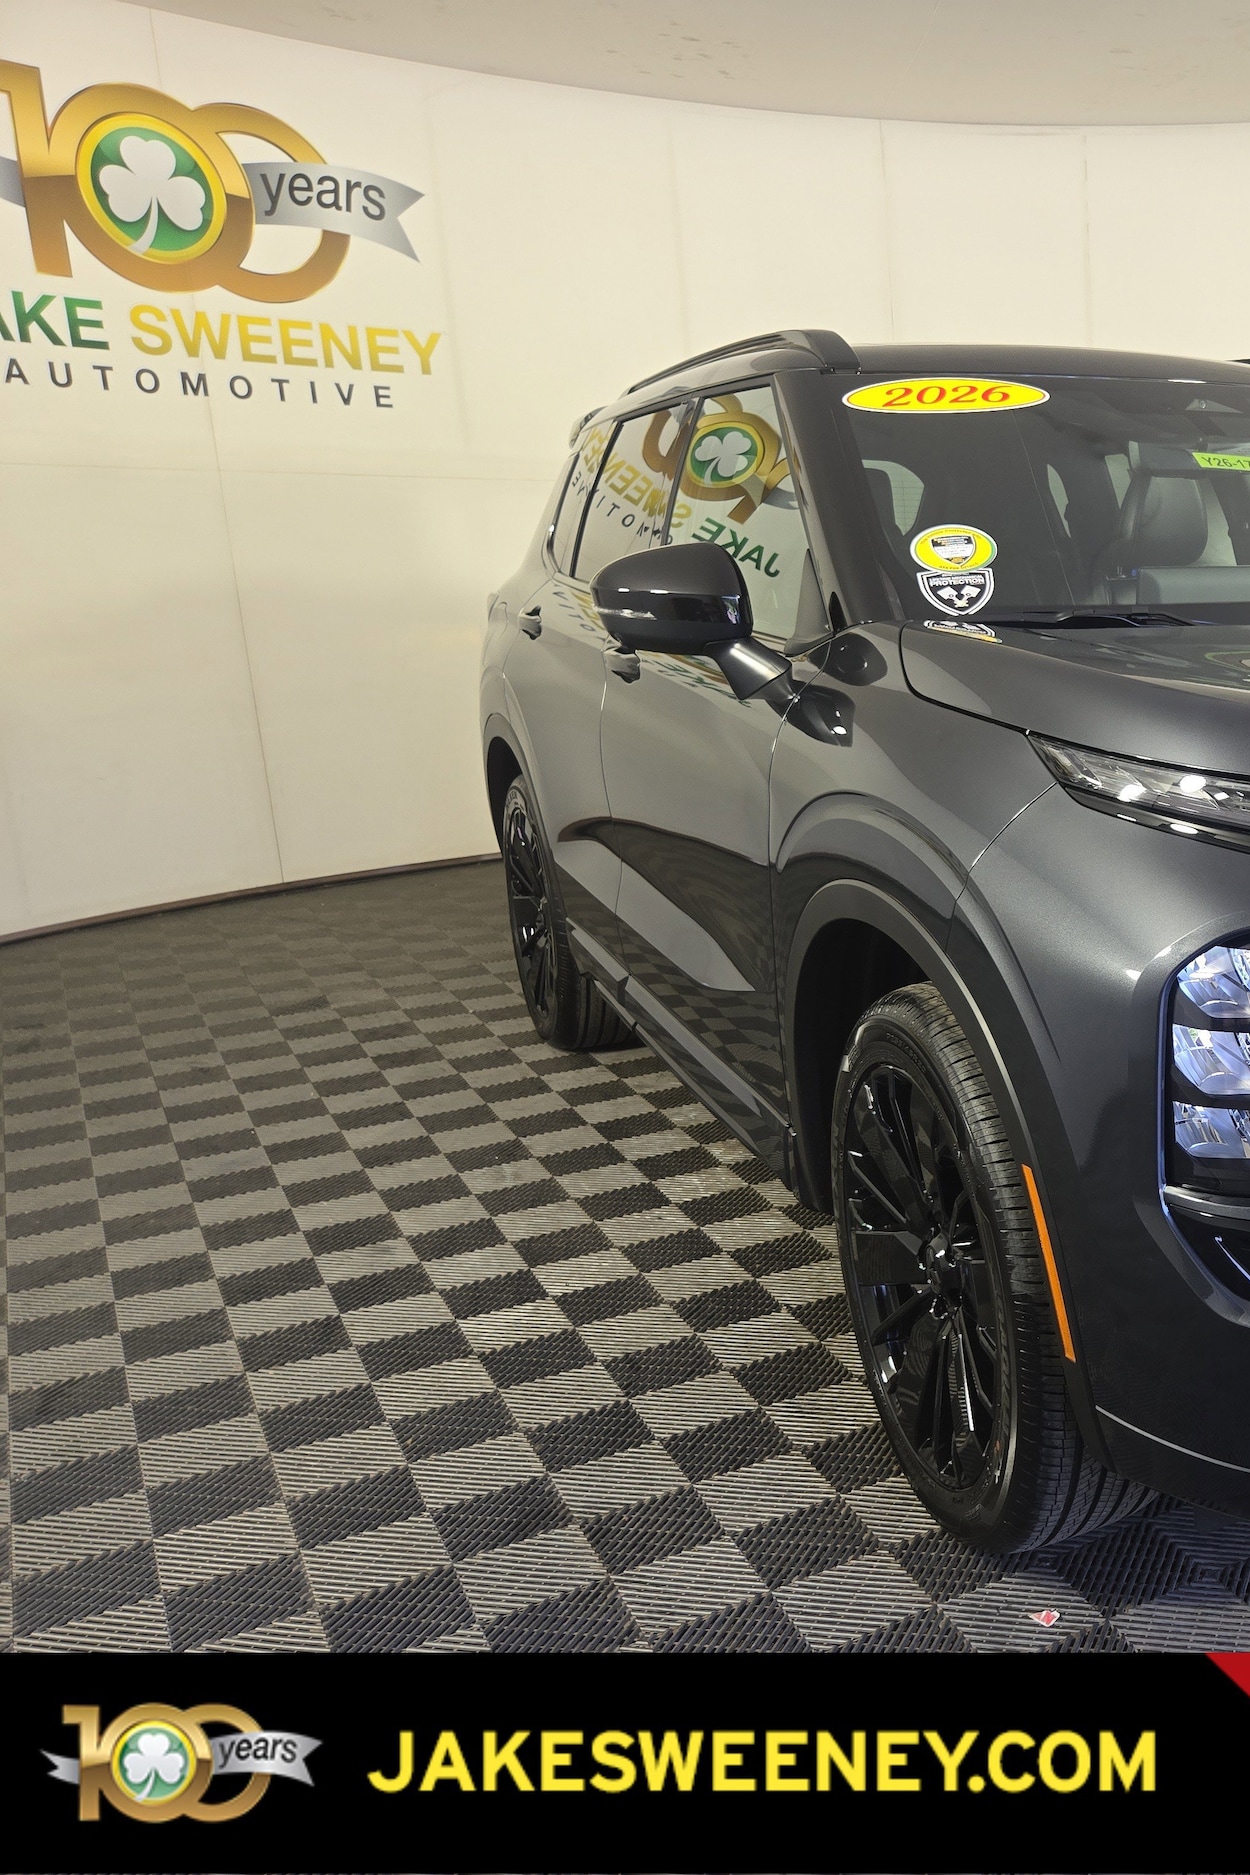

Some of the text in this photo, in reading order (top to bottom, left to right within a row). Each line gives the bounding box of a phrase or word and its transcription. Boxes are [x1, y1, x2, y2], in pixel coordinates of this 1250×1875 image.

[259, 170, 387, 222] years
[0, 290, 442, 376] KE SWEENEY
[4, 357, 394, 409] AUTOMOTIVE
[882, 385, 1013, 407] 2026
[929, 576, 986, 588] PROTECTION
